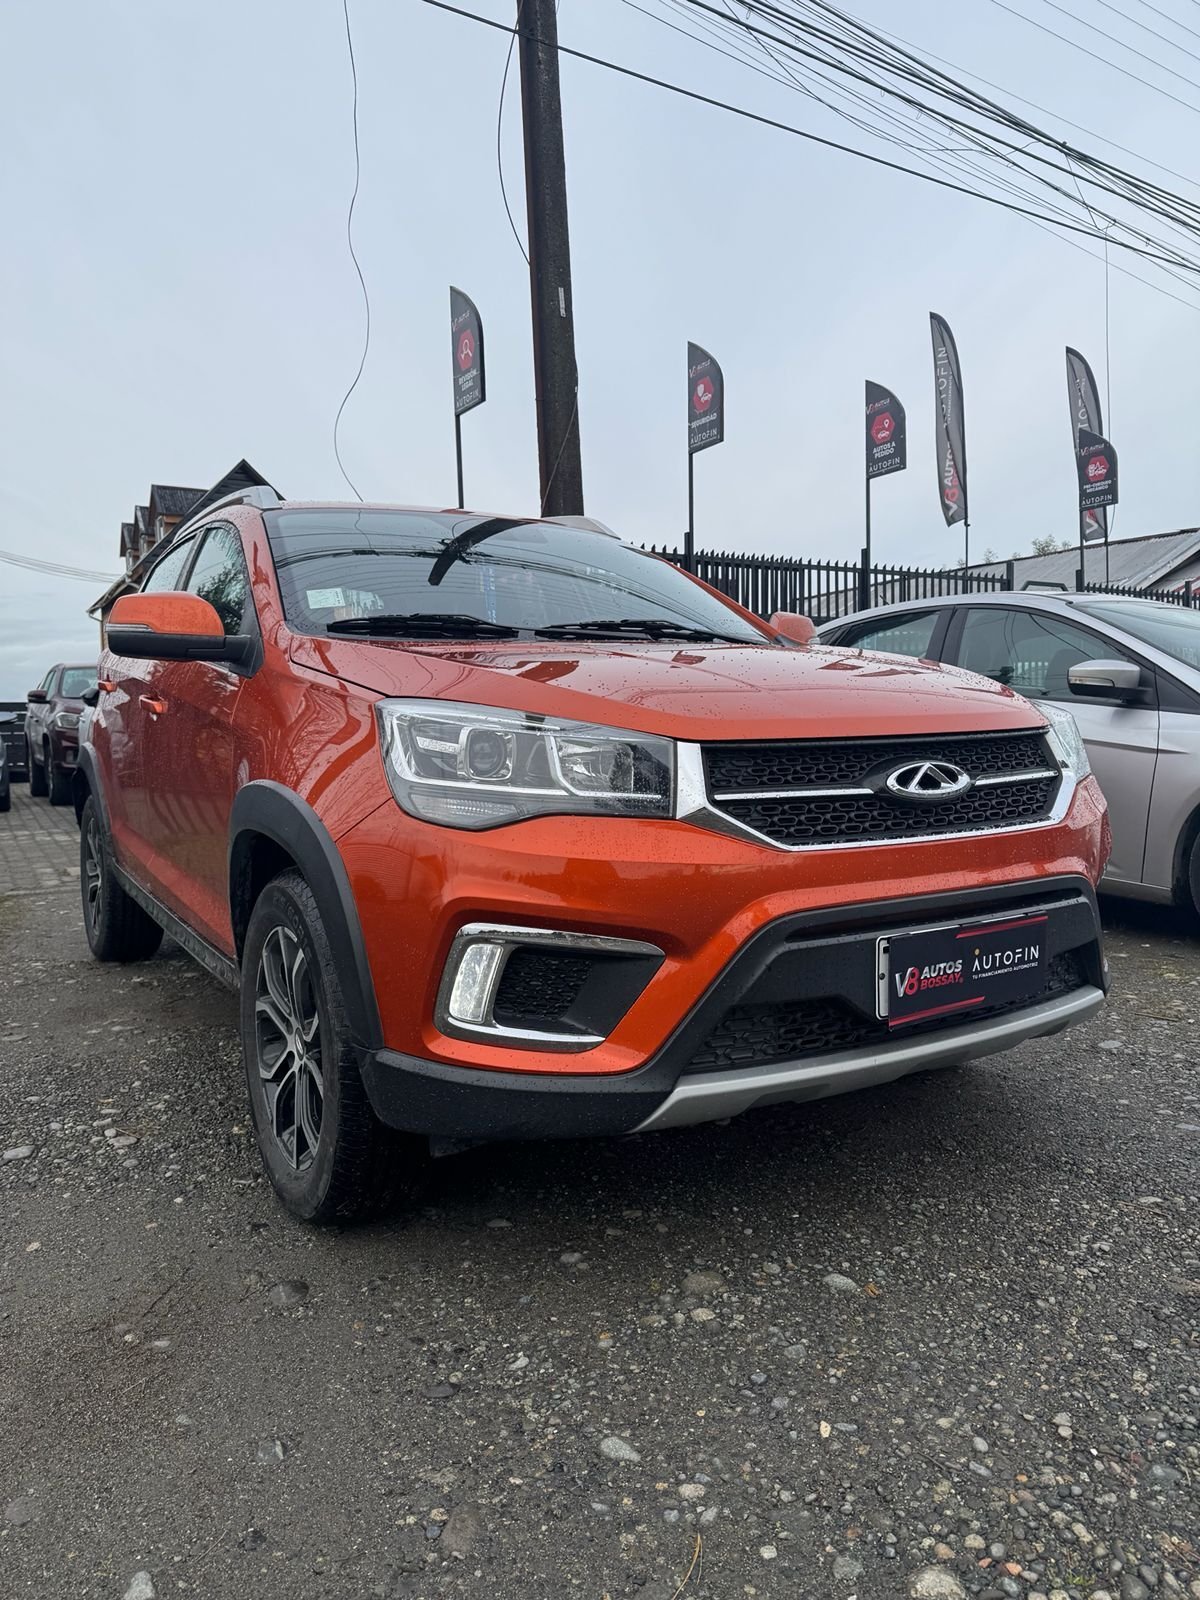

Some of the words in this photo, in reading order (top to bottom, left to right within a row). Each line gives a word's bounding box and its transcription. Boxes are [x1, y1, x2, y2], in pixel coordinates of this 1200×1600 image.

[690, 427, 717, 444] AUTOFIN
[873, 444, 891, 454] AUTOS
[875, 448, 894, 460] PEDIDO
[869, 457, 900, 472] AUTOFIN
[944, 488, 959, 517] V8
[1082, 495, 1112, 505] AUTOFIN
[972, 945, 1039, 972] AUTOFIN
[896, 967, 920, 998] V8
[921, 960, 963, 980] AUTOS
[978, 967, 1012, 979] FINANCIAMIENTO
[1014, 962, 1038, 971] AUTOMOTRIZ
[920, 973, 961, 991] BOSSAY
